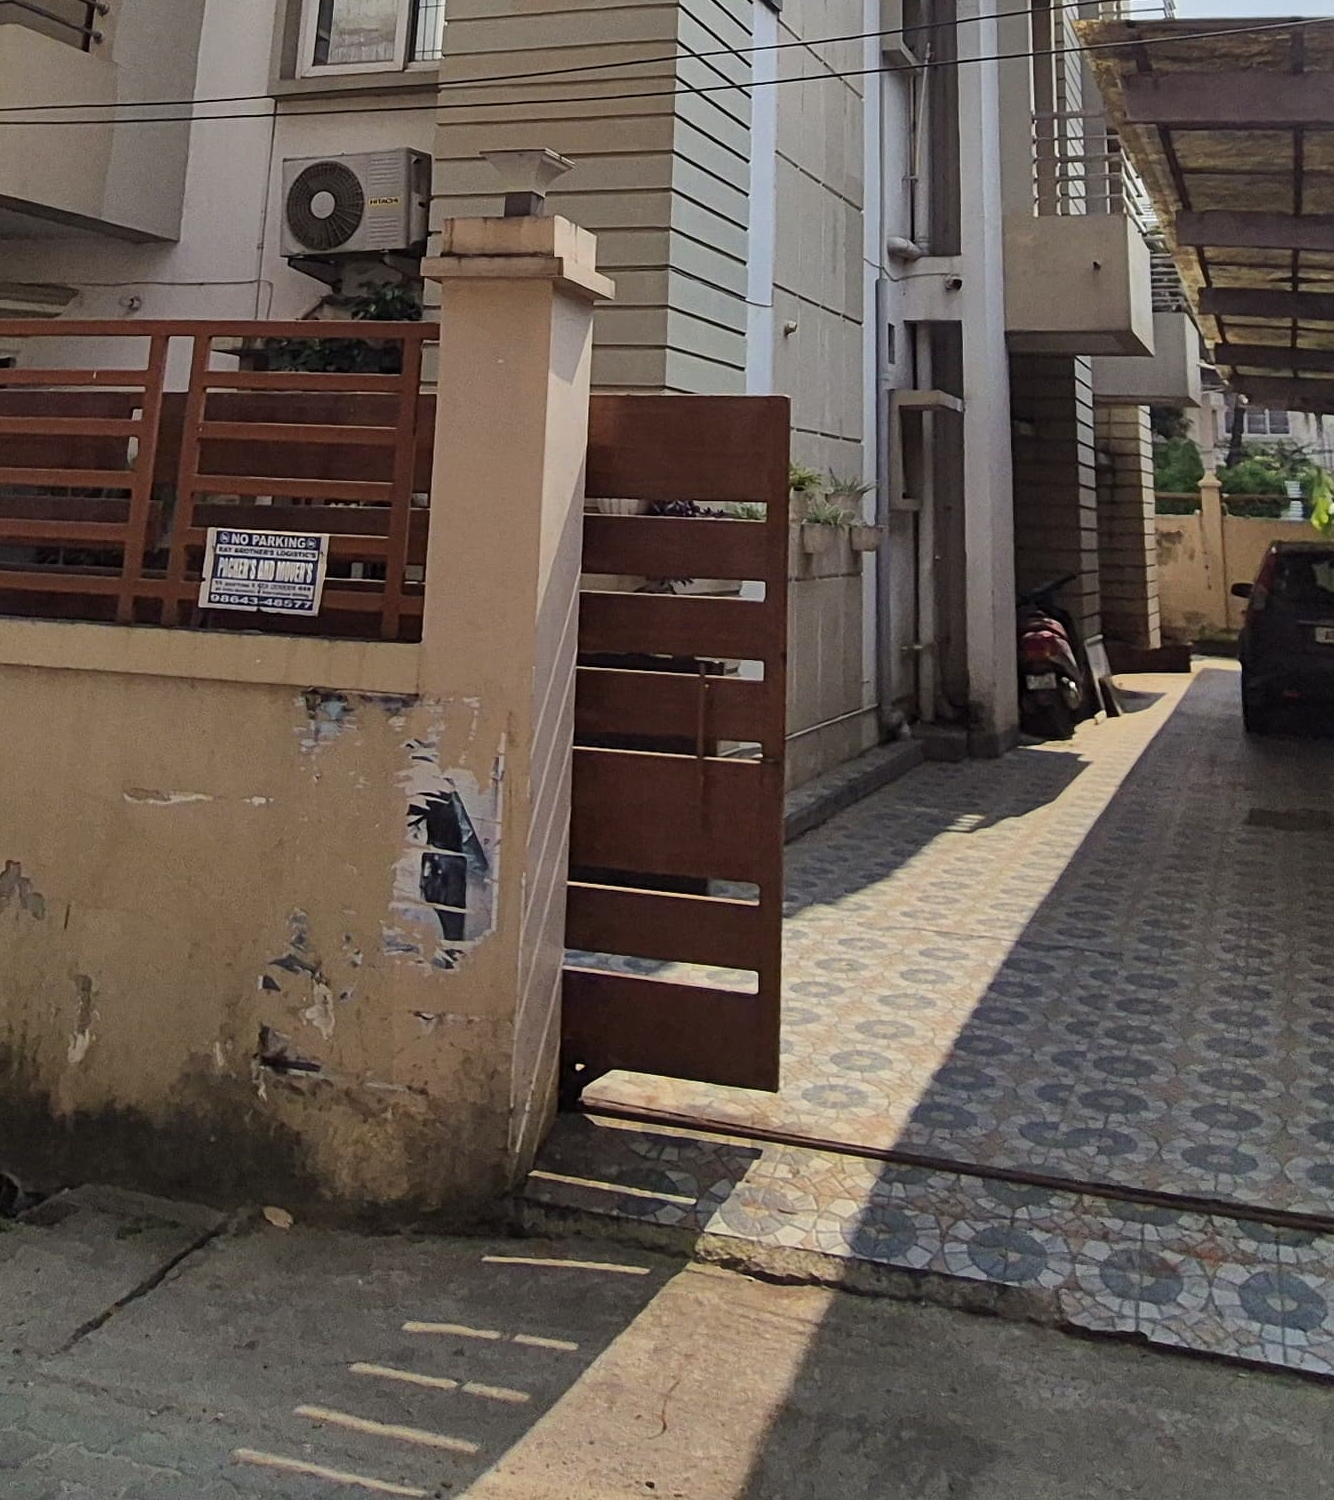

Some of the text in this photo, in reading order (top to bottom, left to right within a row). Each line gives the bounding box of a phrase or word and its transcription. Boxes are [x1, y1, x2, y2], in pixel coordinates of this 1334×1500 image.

[231, 533, 306, 548] NO PARKING
[217, 556, 314, 583] PACKER'S AND MOVER'S
